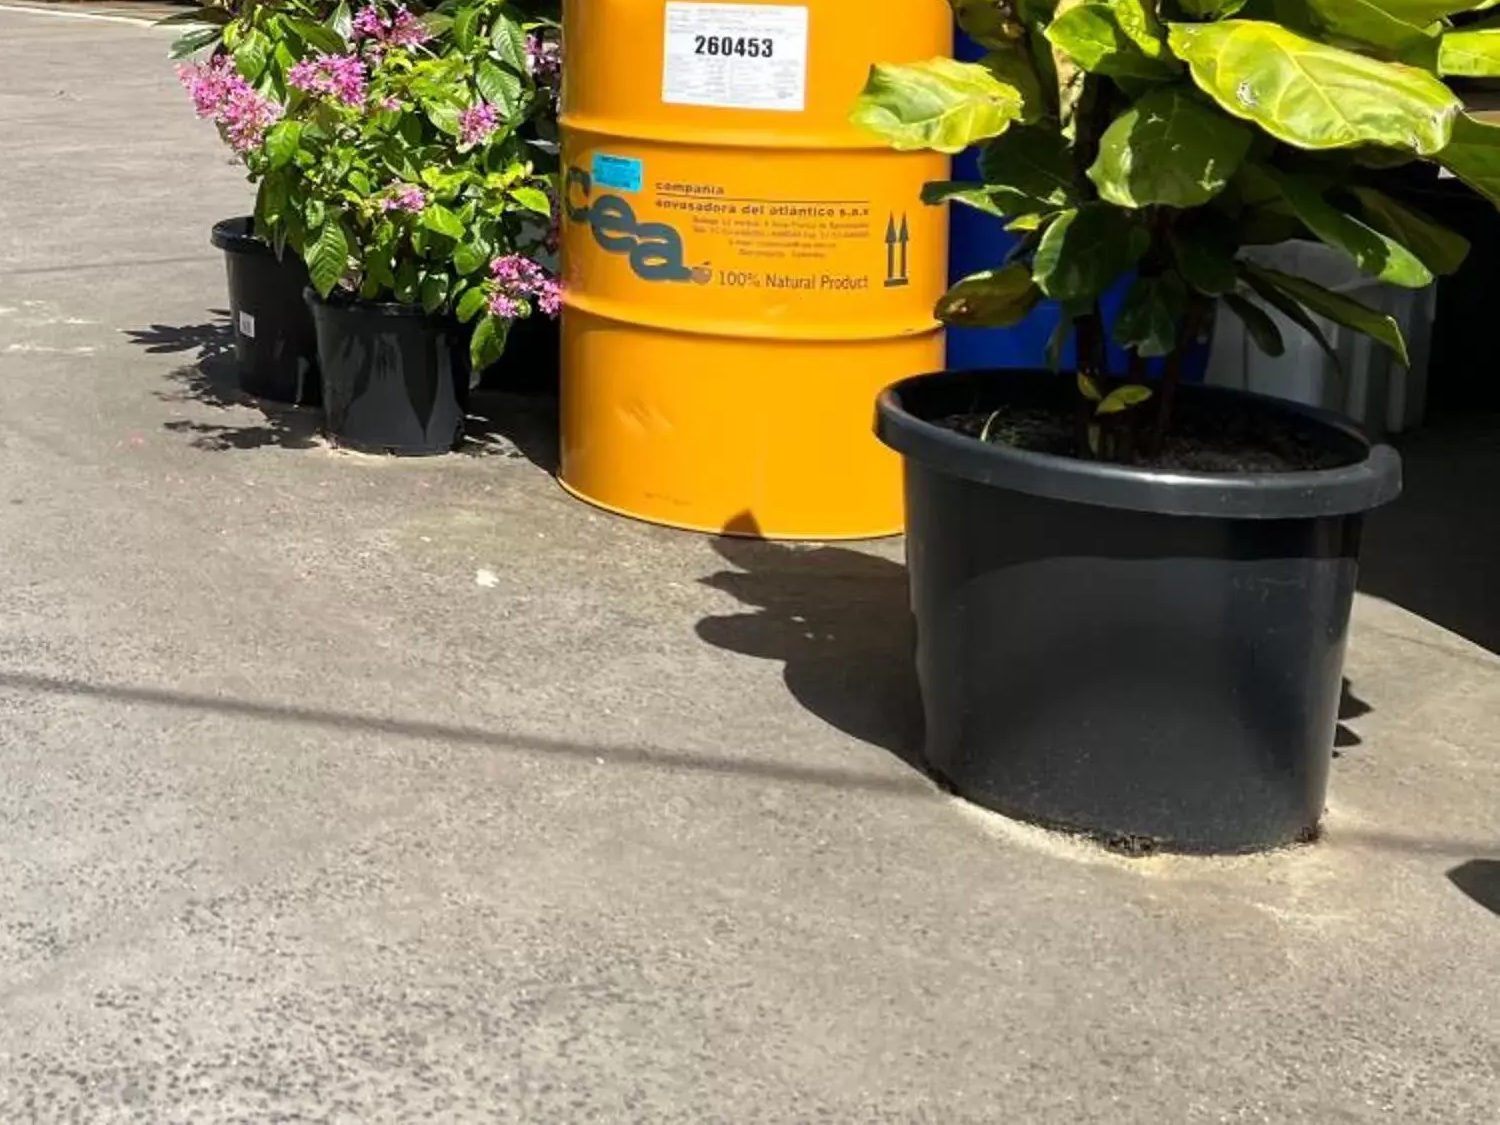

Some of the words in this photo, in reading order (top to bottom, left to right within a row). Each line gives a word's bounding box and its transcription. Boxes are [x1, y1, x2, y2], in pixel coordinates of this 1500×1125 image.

[694, 34, 773, 58] 260453
[741, 205, 765, 216] del
[718, 270, 761, 287] 100%
[765, 274, 815, 290] Natural
[820, 275, 869, 290] Product
